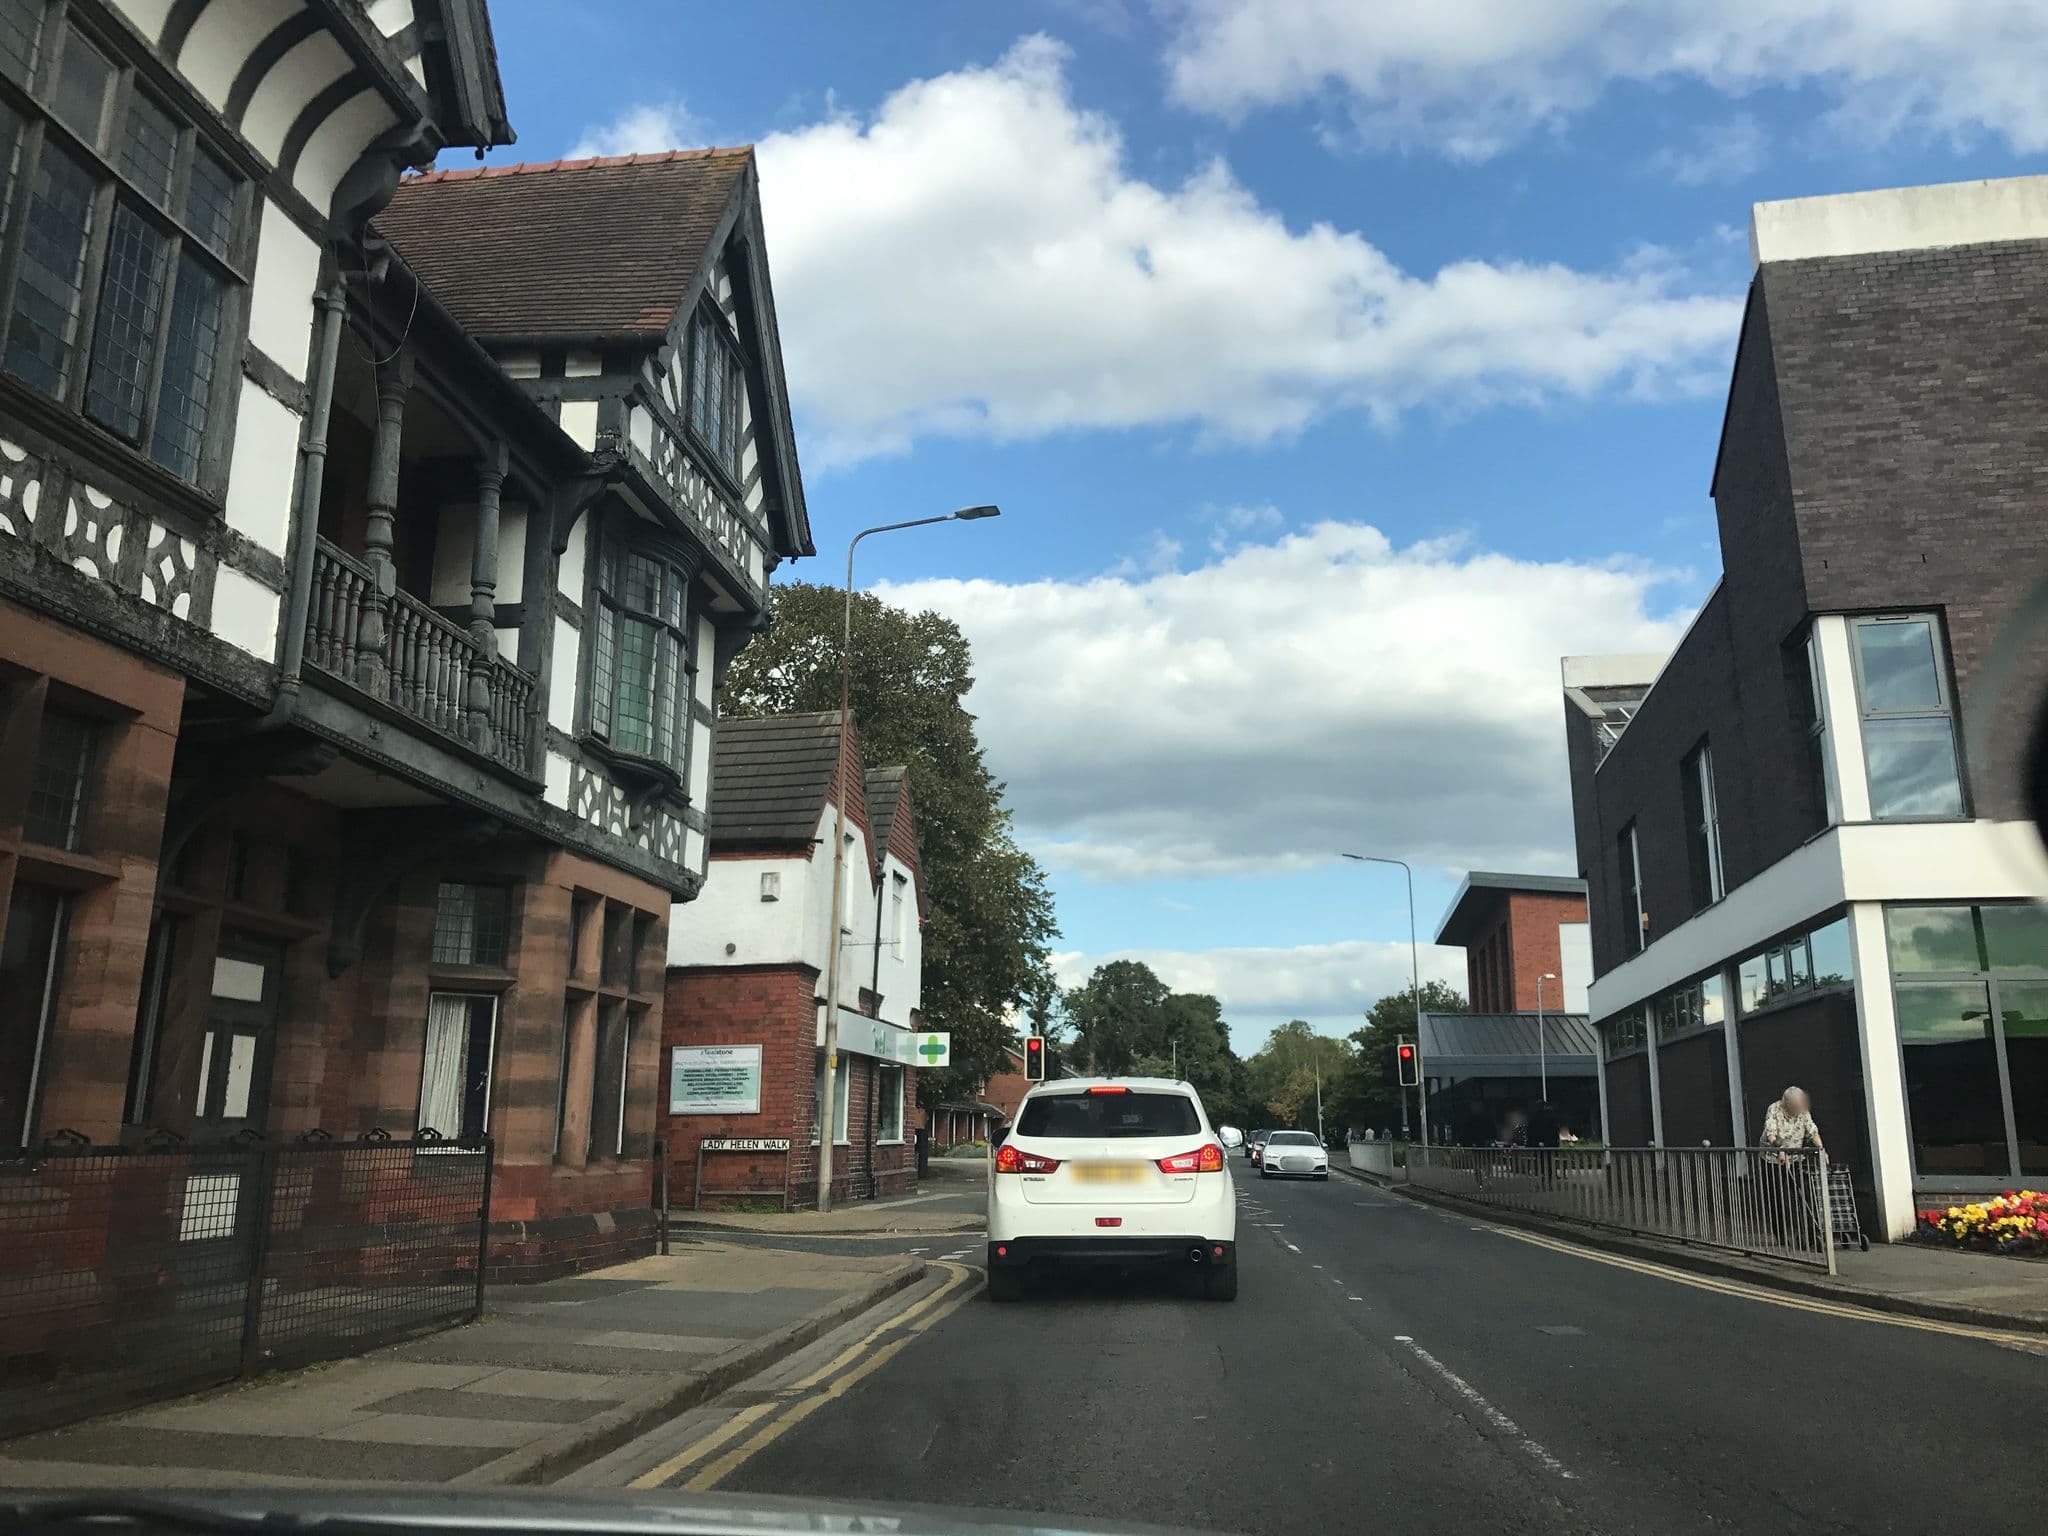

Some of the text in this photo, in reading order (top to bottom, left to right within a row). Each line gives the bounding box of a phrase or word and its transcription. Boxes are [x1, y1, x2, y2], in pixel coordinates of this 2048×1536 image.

[702, 1140, 788, 1149] LADY HELEN WALK
